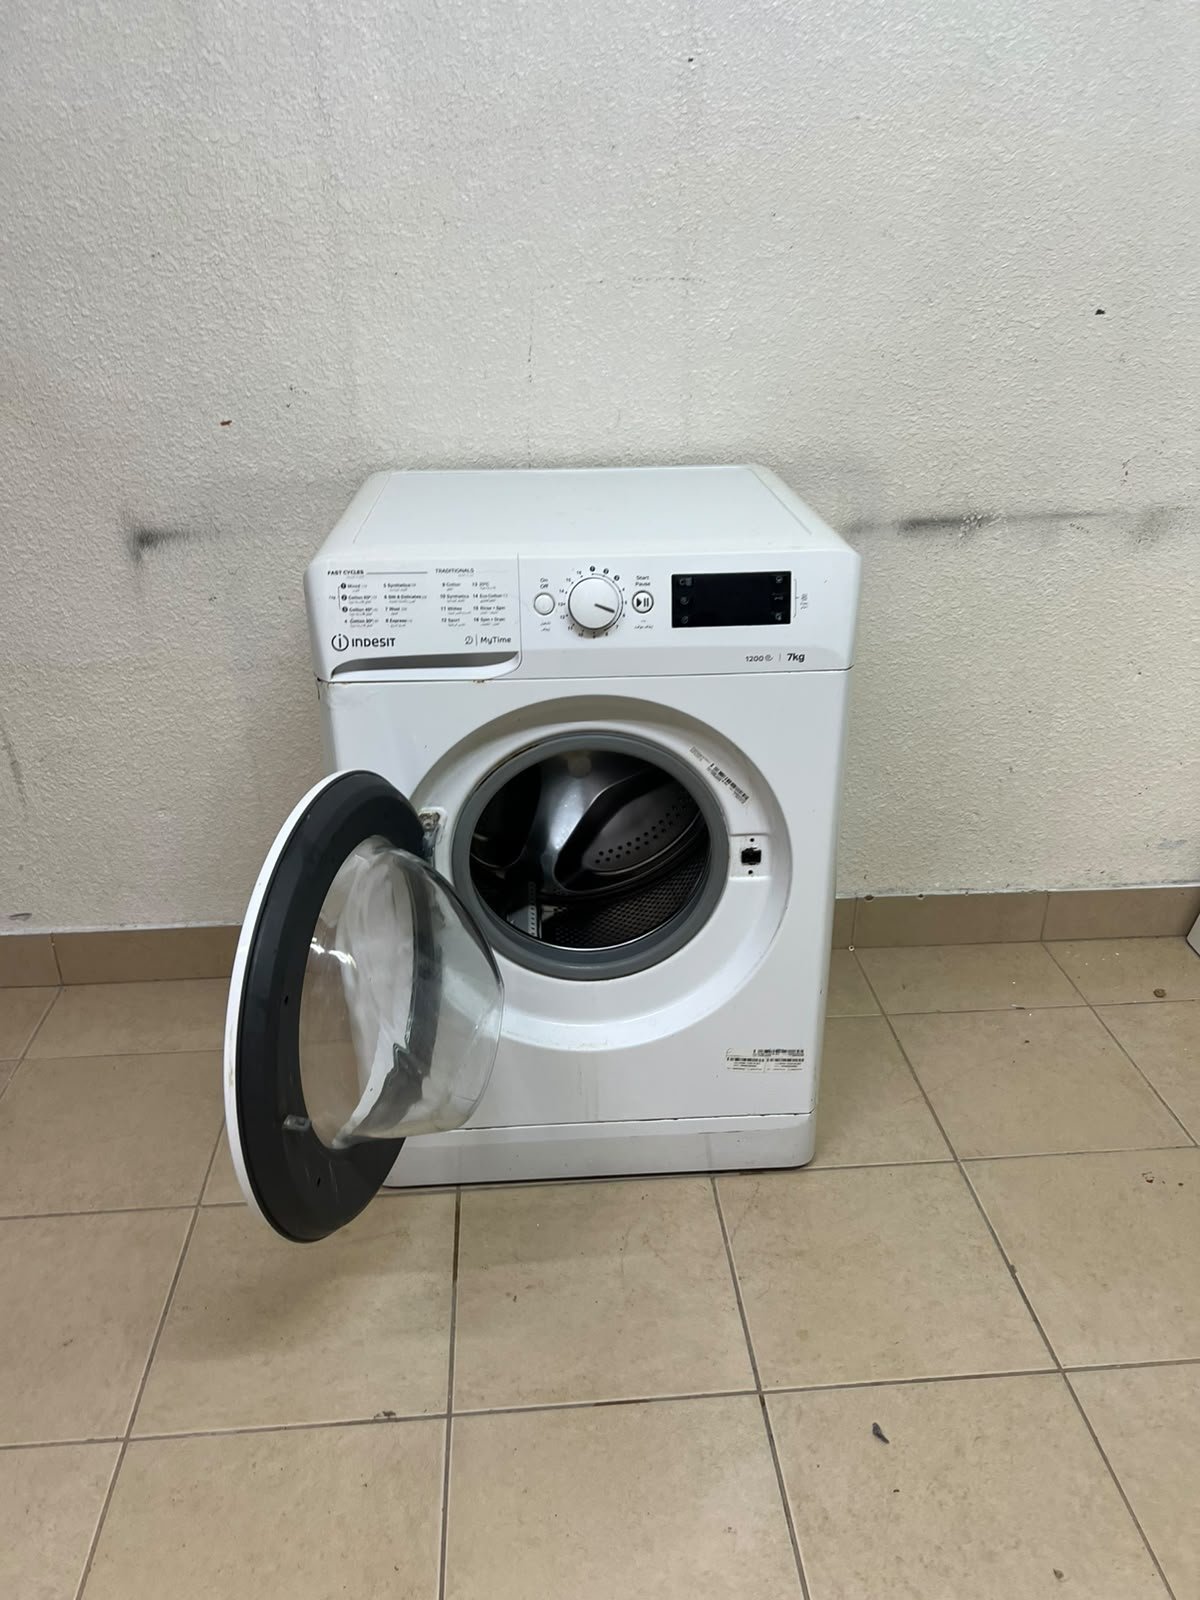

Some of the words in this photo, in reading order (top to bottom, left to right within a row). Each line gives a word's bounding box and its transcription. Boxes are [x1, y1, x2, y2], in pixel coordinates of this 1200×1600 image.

[352, 637, 396, 647] INDESIT
[480, 636, 511, 645] MyTime
[787, 653, 805, 662] 7kg
